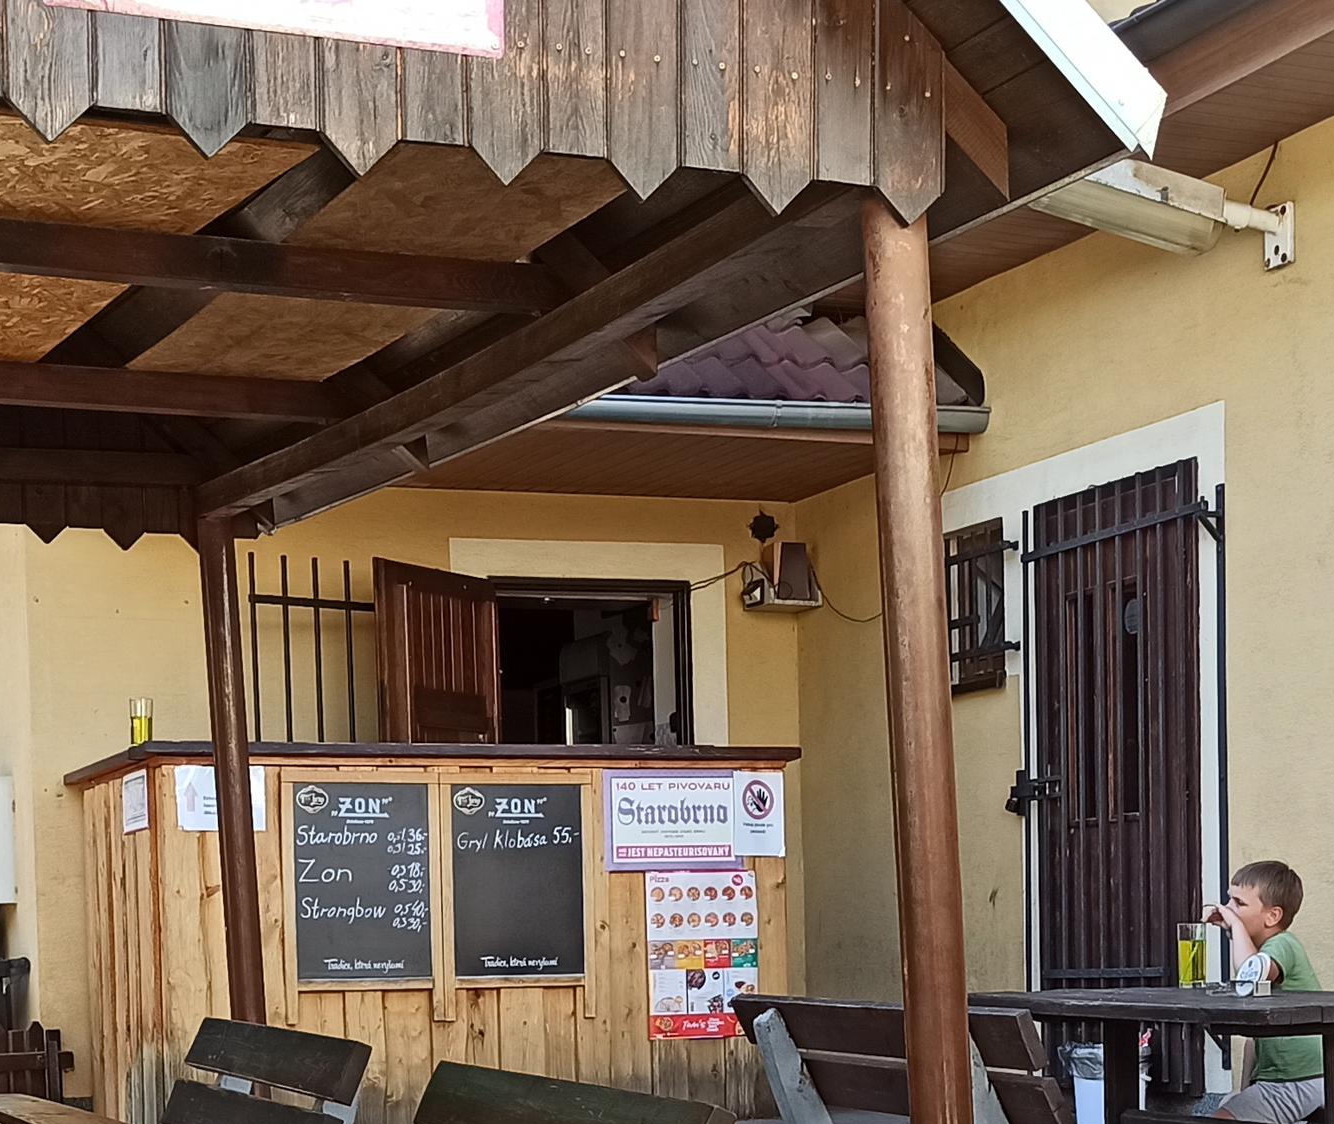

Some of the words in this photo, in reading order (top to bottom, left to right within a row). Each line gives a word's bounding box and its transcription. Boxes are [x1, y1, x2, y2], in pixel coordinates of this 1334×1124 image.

[616, 782, 636, 791] 140
[641, 783, 663, 791] LET
[668, 782, 730, 791] PIVOVARU
[617, 796, 729, 825] Starobrno
[296, 825, 378, 845] Starobrno
[493, 829, 548, 850] Klobása
[627, 848, 645, 857] JEST
[298, 859, 353, 882] Zon
[300, 896, 387, 924] Strongbow
